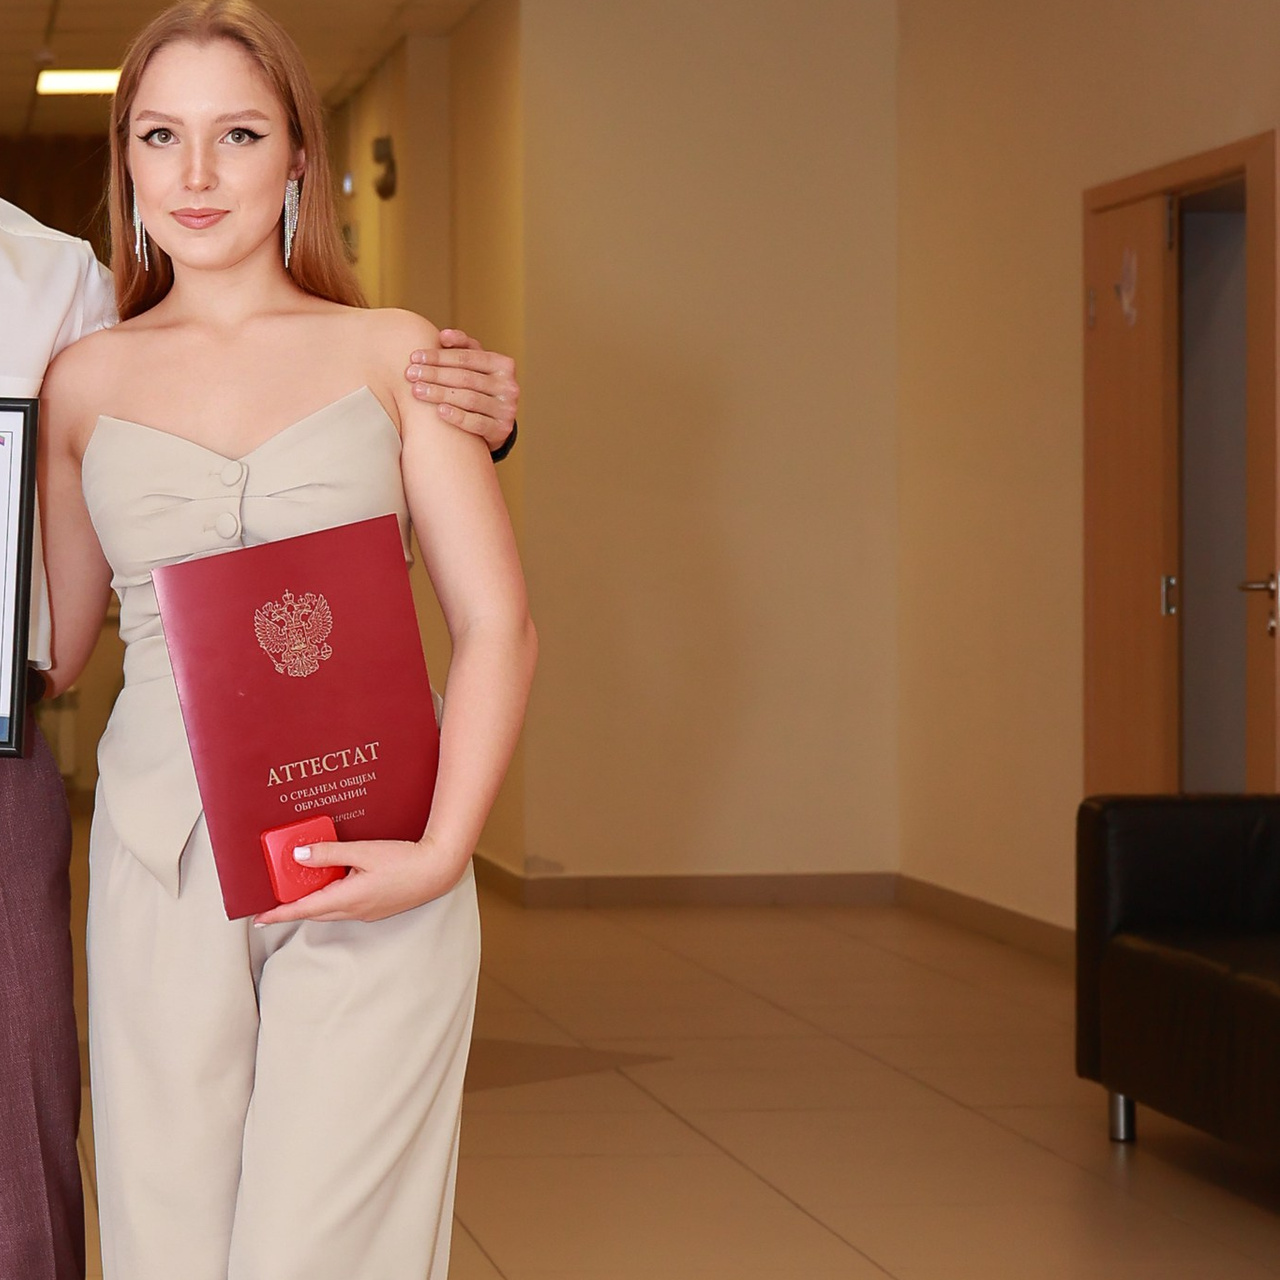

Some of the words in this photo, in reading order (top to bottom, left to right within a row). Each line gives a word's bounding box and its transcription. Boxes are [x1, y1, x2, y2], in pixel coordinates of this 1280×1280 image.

[267, 742, 380, 787] АТТЕСТАТ
[280, 794, 288, 803] О
[290, 782, 337, 801] СРЕДНЕМ
[340, 772, 377, 788] ОБЩЕМ
[294, 787, 367, 812] ОБРАЗОВАНИИ
